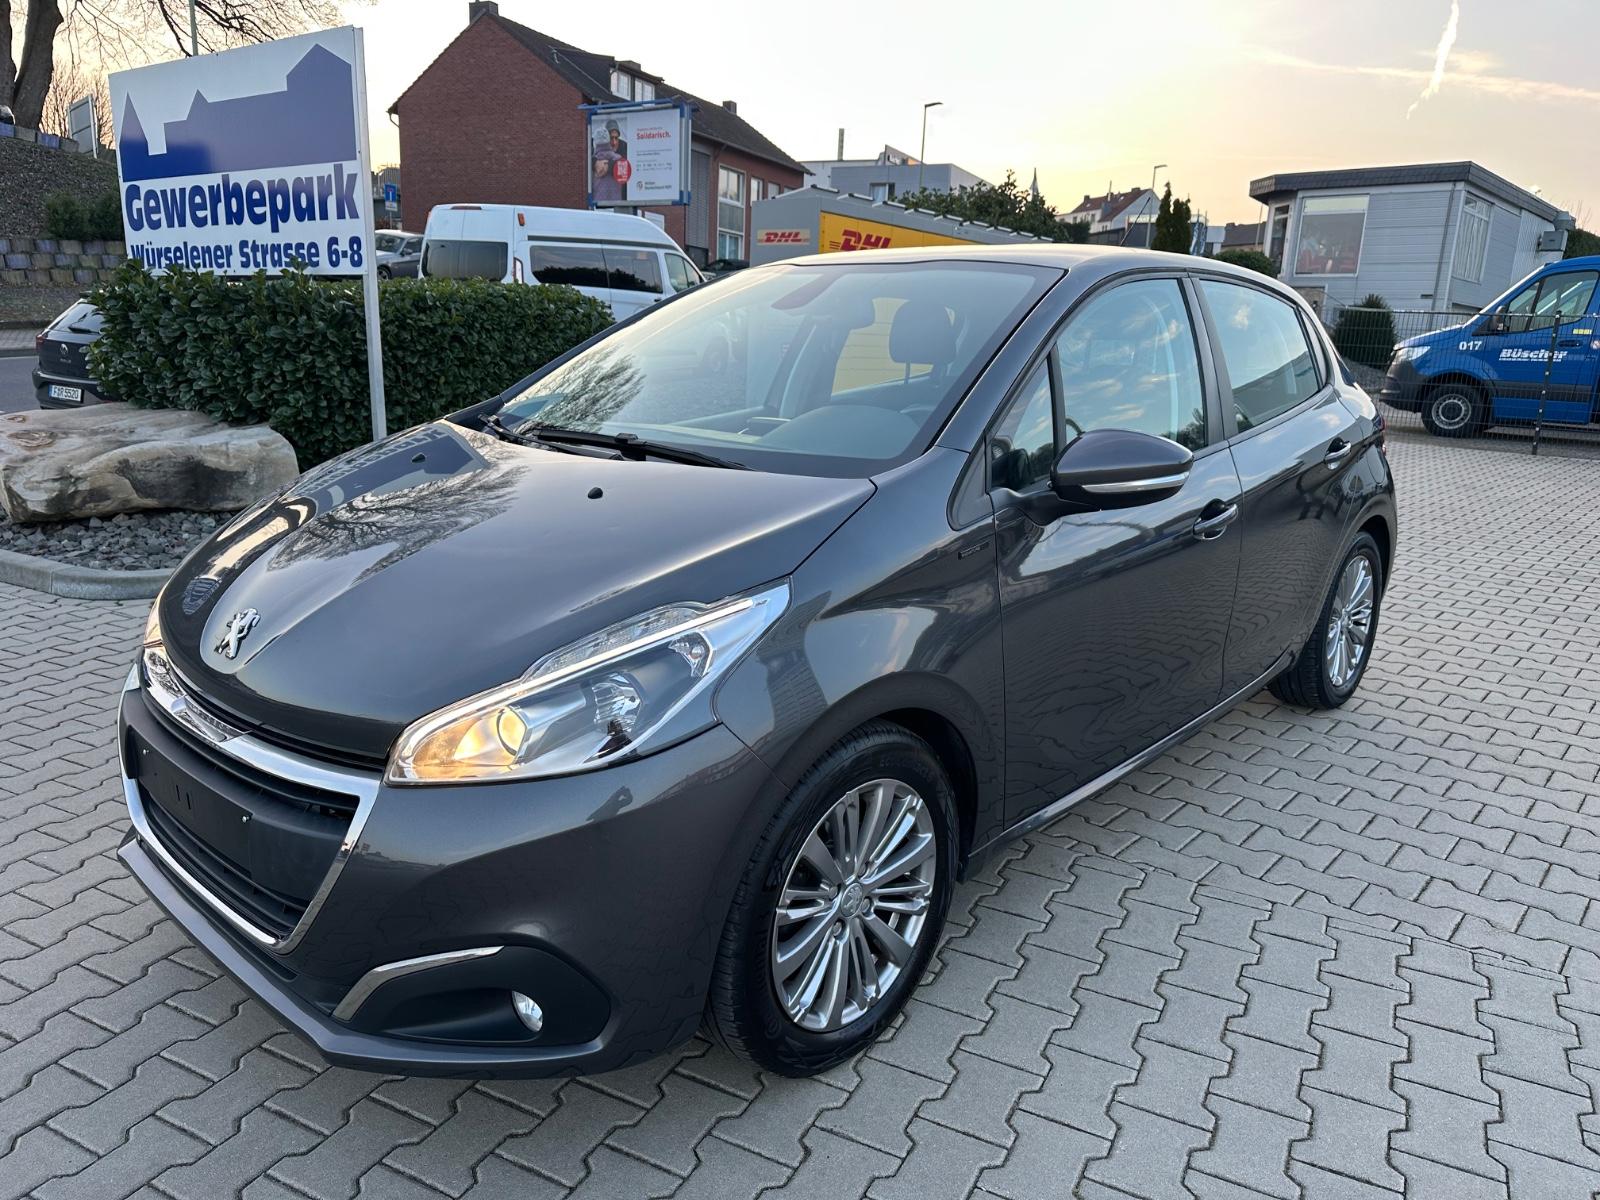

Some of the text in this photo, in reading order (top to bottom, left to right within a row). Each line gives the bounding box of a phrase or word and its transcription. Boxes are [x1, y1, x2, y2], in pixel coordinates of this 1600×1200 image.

[125, 163, 360, 233] Gewerbepark
[764, 231, 802, 243] DHL
[130, 235, 363, 270] Würselener Strasse 6-8
[1458, 340, 1483, 351] 017
